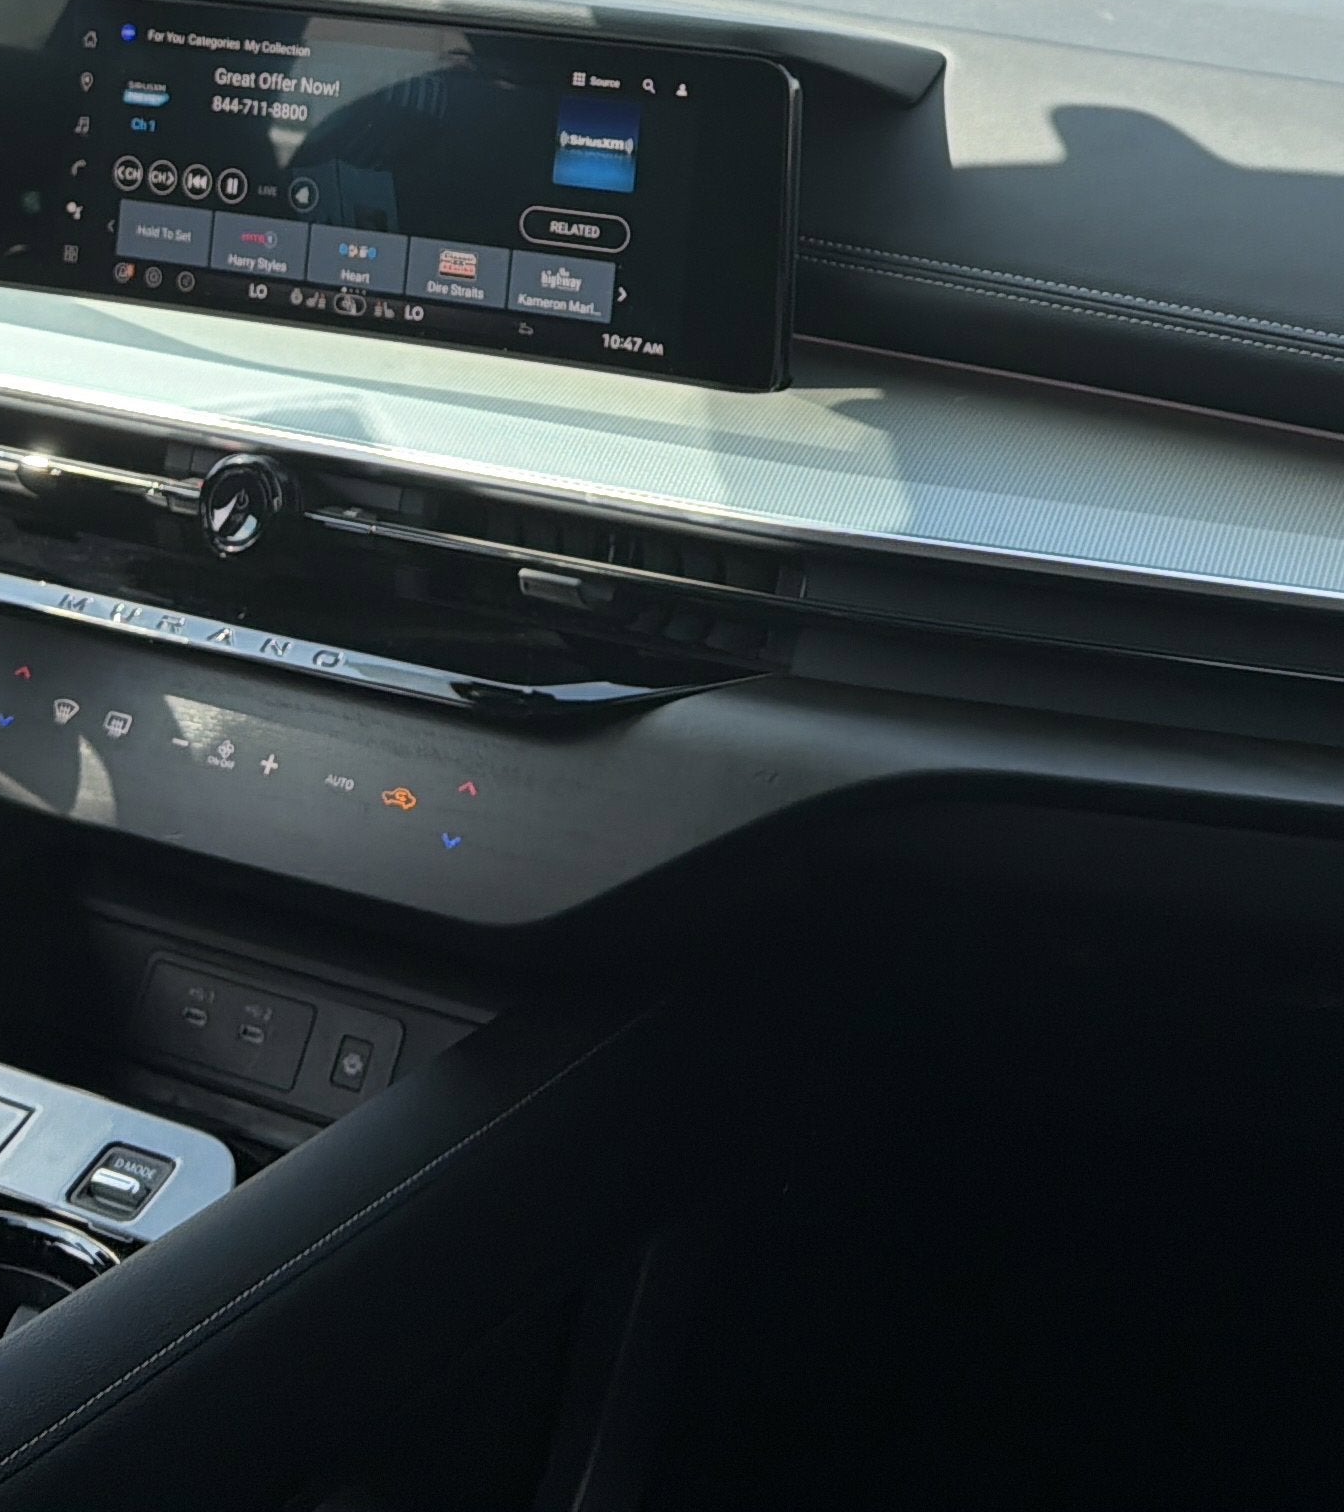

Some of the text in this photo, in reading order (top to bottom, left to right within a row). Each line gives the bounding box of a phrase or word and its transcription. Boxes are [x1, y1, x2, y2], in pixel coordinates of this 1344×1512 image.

[147, 28, 185, 45] For You
[187, 33, 241, 51] Categories
[244, 39, 311, 57] My Collection
[214, 67, 340, 97] Great Offer Now!
[589, 75, 621, 89] Source
[212, 95, 308, 121] 844-711-8800
[130, 117, 147, 131] Ch
[135, 223, 192, 242] Hold To Set
[549, 220, 601, 239] RELATED
[228, 253, 287, 273] Harry Styles
[340, 269, 370, 284] Heart
[540, 270, 583, 292] highway
[248, 283, 268, 300] LO
[426, 280, 484, 300] Dire Straits
[517, 293, 566, 311] Kameron
[404, 304, 424, 322] LO
[601, 333, 664, 357] 10:47 AM
[58, 592, 347, 670] MURANO
[324, 773, 355, 792] AUTO
[124, 1160, 156, 1180] MODE
